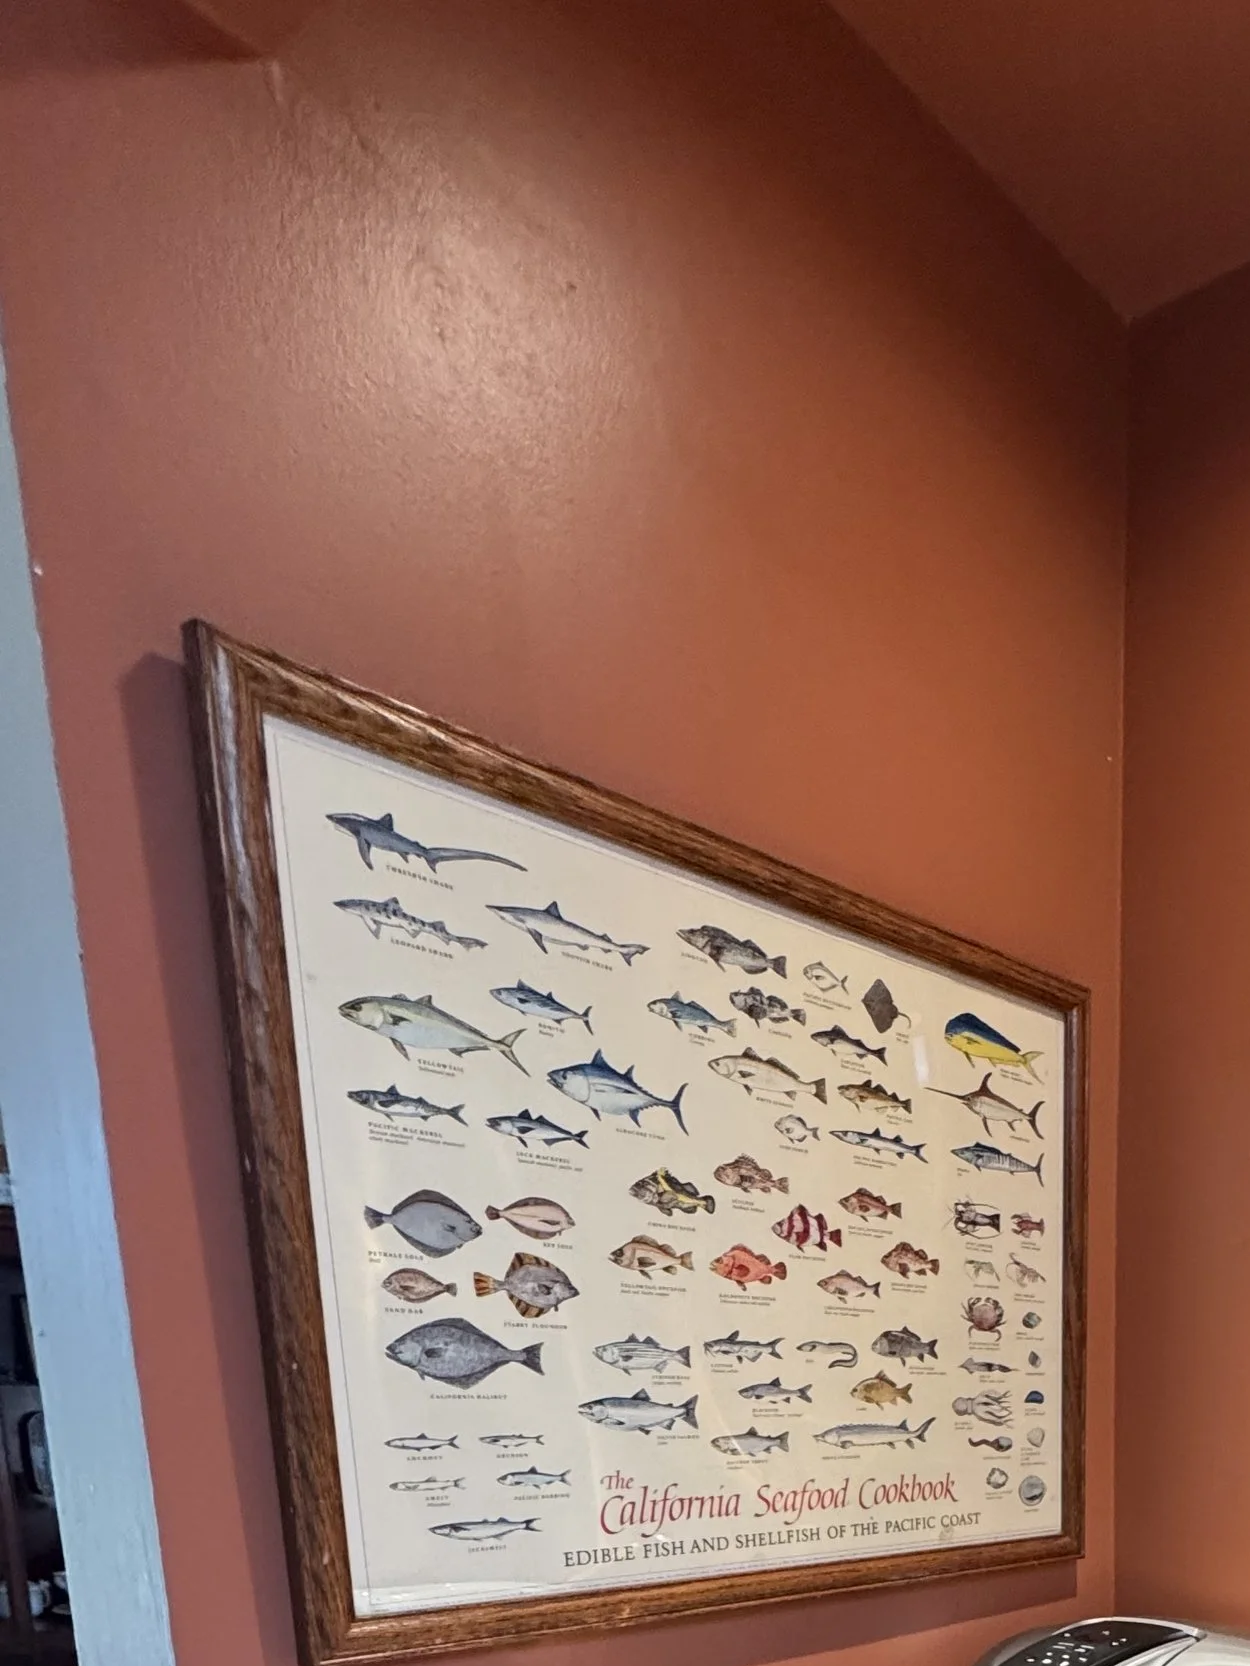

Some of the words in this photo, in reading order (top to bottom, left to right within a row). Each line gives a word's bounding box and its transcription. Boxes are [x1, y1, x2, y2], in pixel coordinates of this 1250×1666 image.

[600, 1470, 634, 1490] The
[600, 1483, 741, 1538] California
[754, 1477, 850, 1525] Seafood
[858, 1472, 958, 1510] Cookbook
[563, 1545, 636, 1567] EDIBLE
[643, 1541, 685, 1559] FISH
[690, 1536, 729, 1554] AND
[735, 1527, 821, 1549] SHELLFISH
[827, 1525, 846, 1540] OF
[851, 1521, 879, 1537] THE
[885, 1516, 936, 1534] PACIFIC
[940, 1512, 981, 1530] COAST
